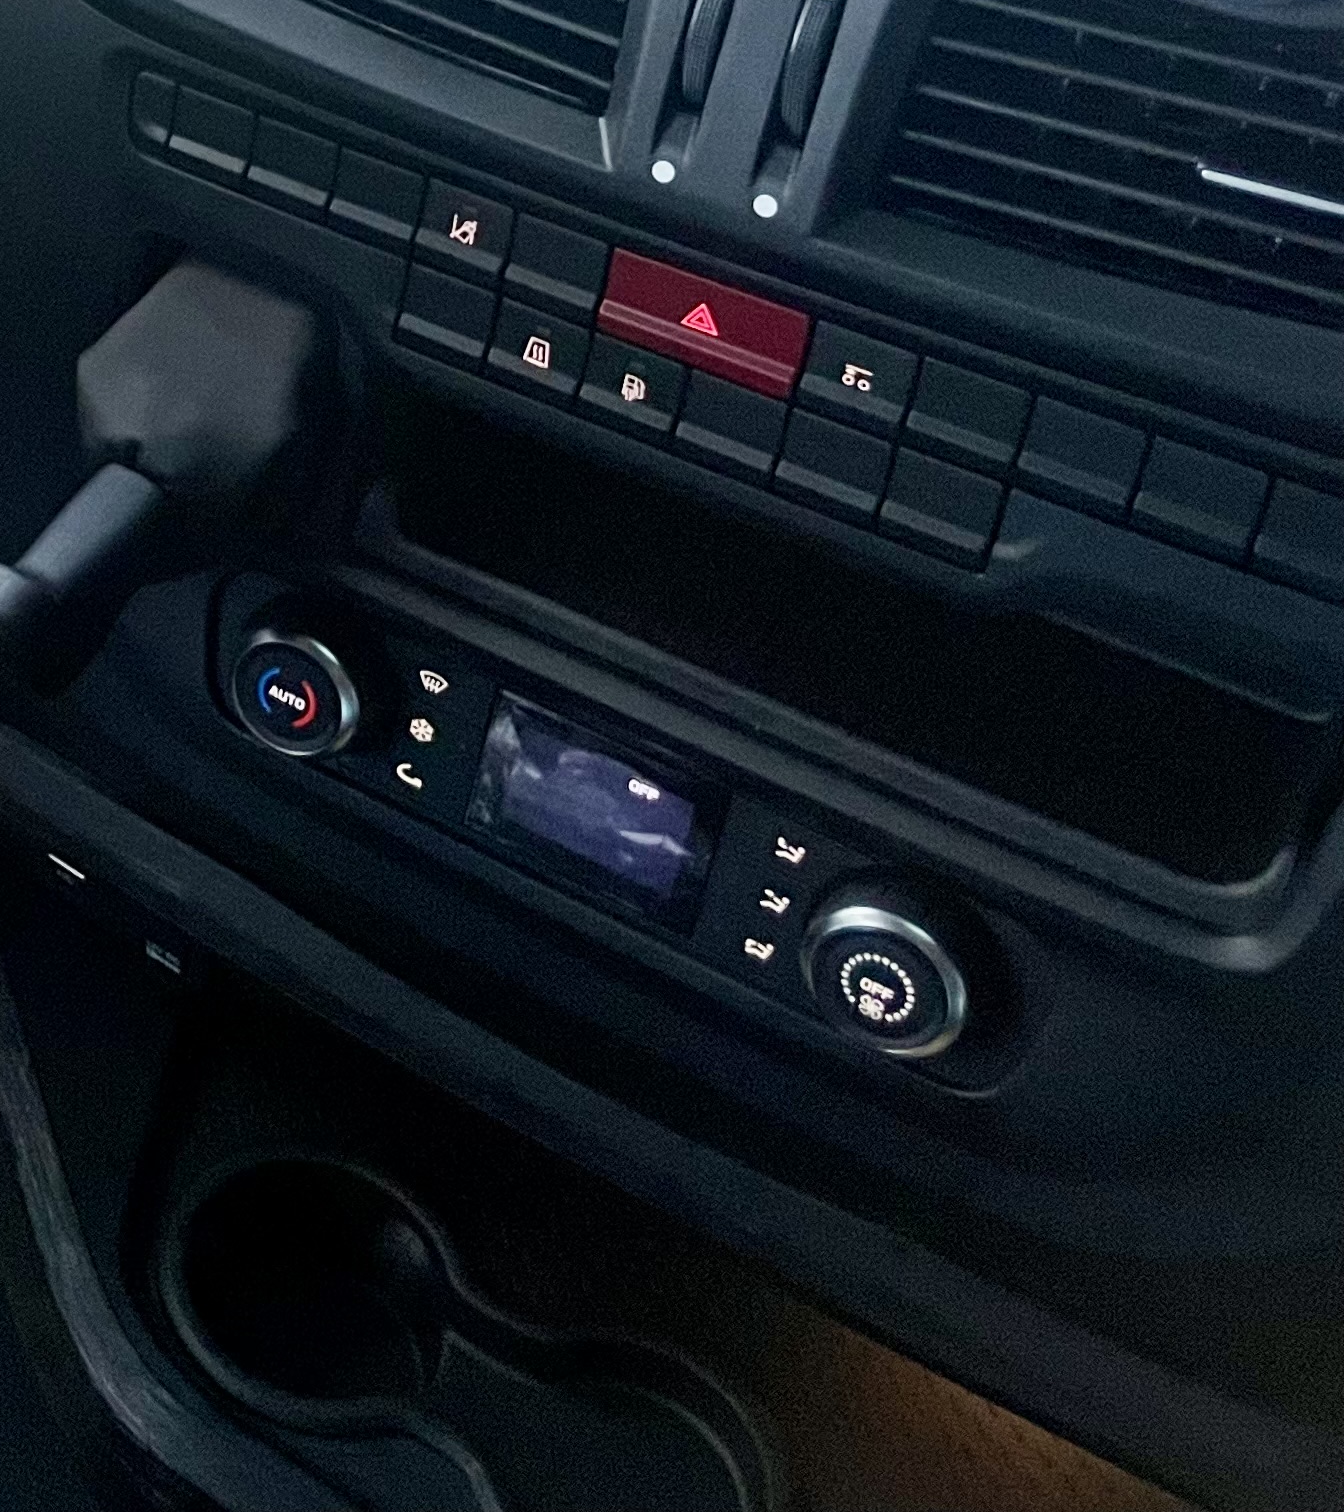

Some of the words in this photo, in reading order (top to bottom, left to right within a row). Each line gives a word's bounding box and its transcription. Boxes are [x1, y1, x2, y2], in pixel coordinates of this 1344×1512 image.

[268, 684, 306, 711] AUTO
[628, 778, 660, 800] OFF
[859, 977, 895, 1000] OFF
